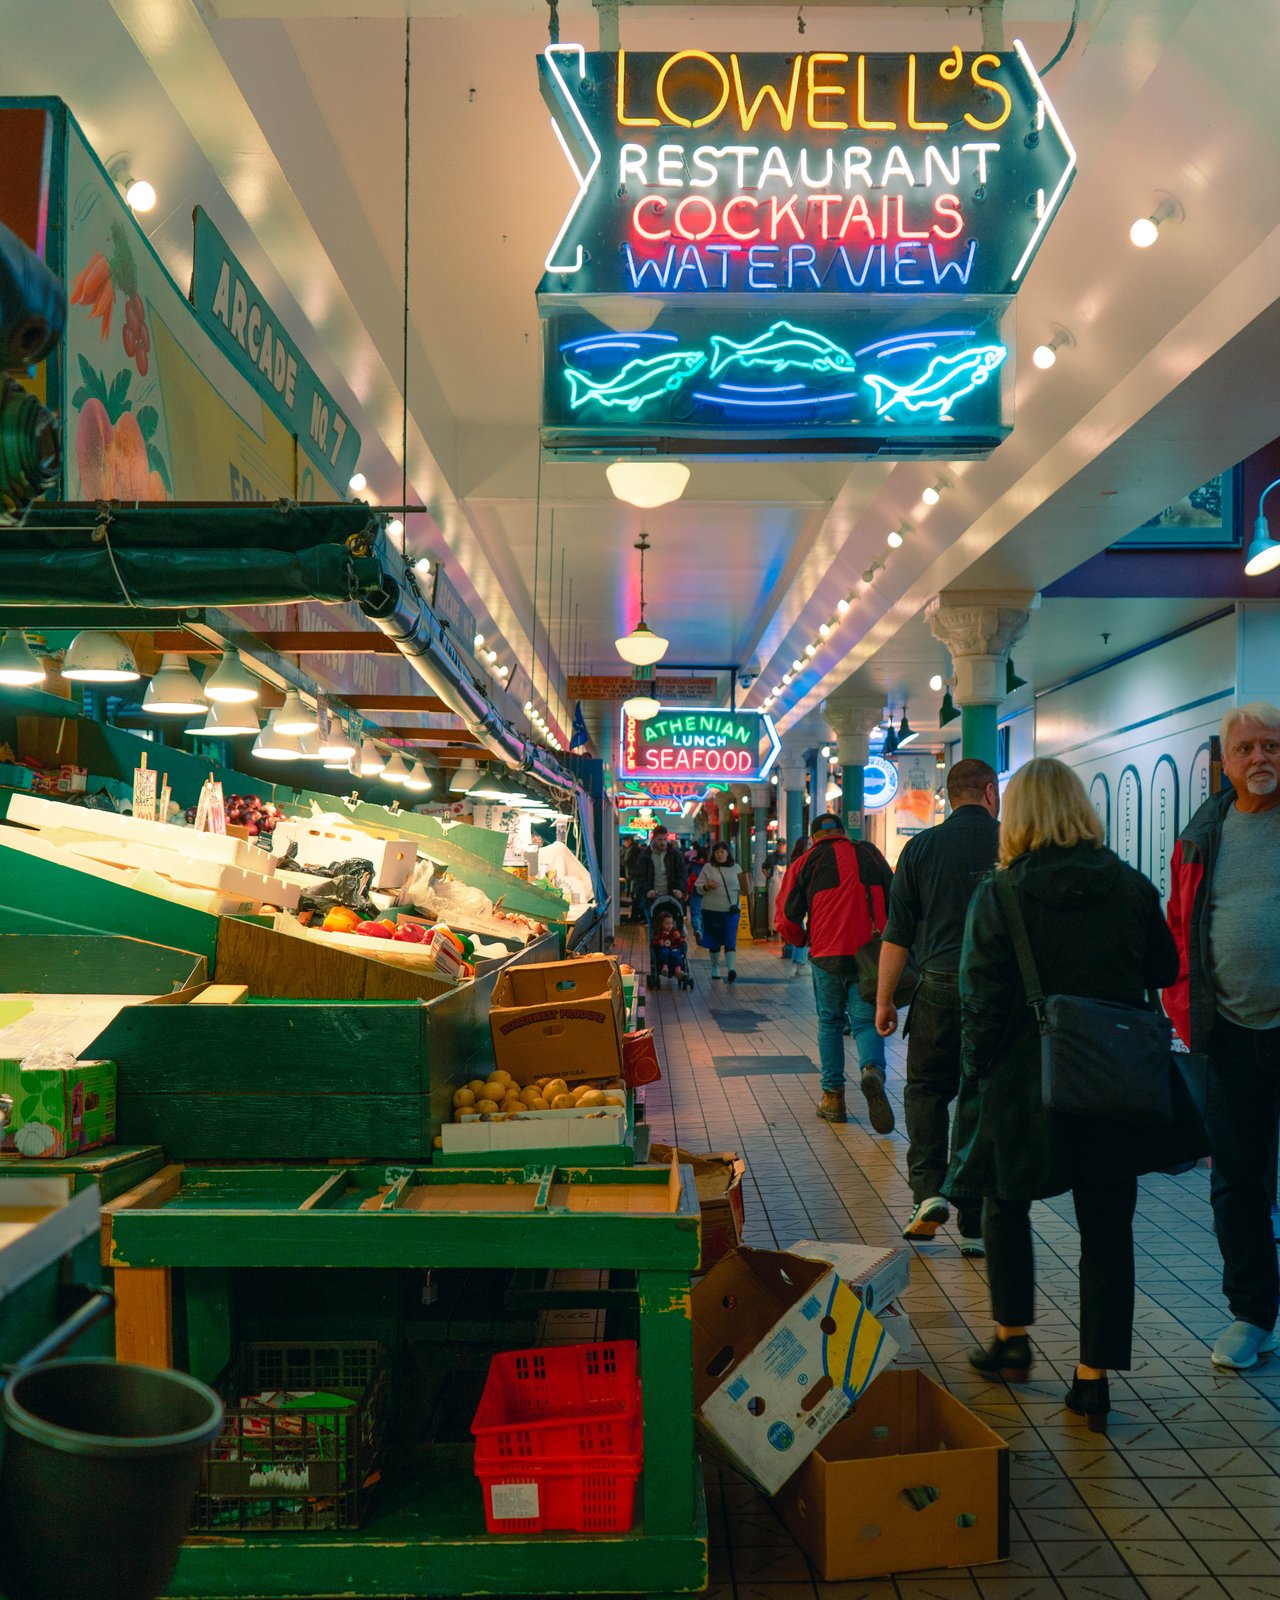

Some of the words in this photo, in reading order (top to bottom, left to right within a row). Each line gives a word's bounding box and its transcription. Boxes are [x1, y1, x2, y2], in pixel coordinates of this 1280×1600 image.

[617, 46, 1012, 131] LOWELL'S
[619, 143, 1000, 189] RESTAURANT
[632, 194, 964, 240] COCKTAILS
[624, 242, 819, 290] WATER
[837, 241, 976, 287] VIEW
[212, 257, 298, 412] ARCADE
[330, 409, 349, 469] 7
[645, 716, 751, 745] ATHENIAN
[673, 735, 727, 747] LUNCH
[646, 748, 752, 772] SEAFOOD
[499, 1009, 559, 1036] NORTHWEST
[560, 1009, 606, 1025] PRODUCE
